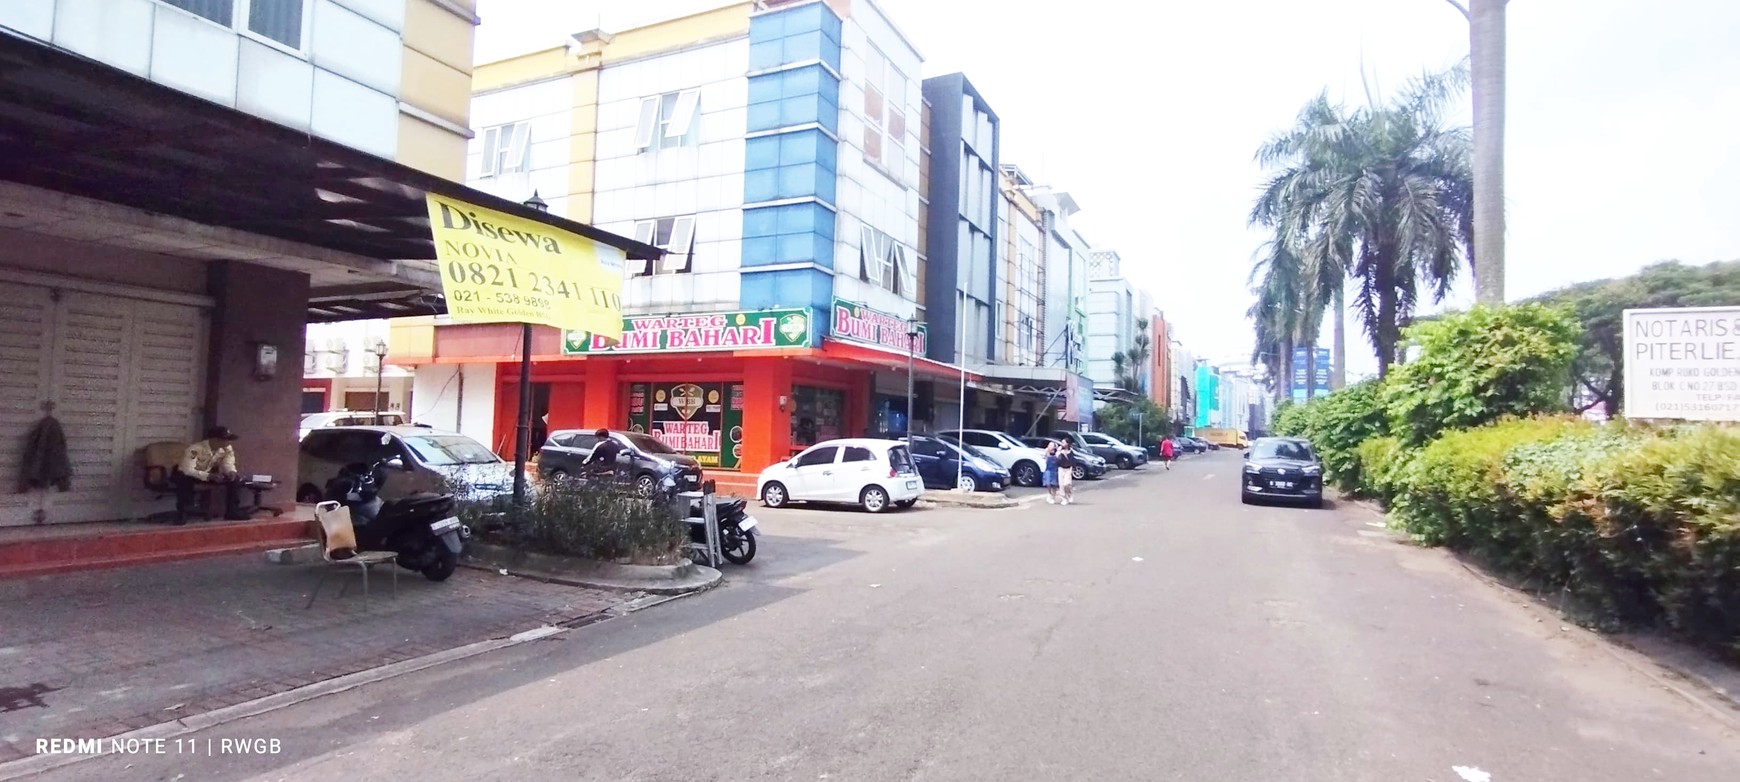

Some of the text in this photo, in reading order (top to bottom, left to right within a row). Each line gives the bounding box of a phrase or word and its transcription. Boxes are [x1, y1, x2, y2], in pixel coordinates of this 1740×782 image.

[440, 202, 562, 254] Disewa
[445, 239, 517, 264] NOVIA
[449, 260, 518, 288] 0821
[528, 272, 582, 300] 2341
[454, 290, 481, 302] 021
[495, 292, 520, 304] 538
[634, 315, 726, 330] WARTEG
[837, 308, 877, 342] BUMI
[861, 308, 908, 331] WARTEG
[1635, 319, 1729, 338] NOTARIS
[669, 319, 775, 348] BAHARI
[1677, 367, 1699, 377] RUKO
[1652, 381, 1675, 391] BLOK
[665, 422, 707, 435] WARTEG
